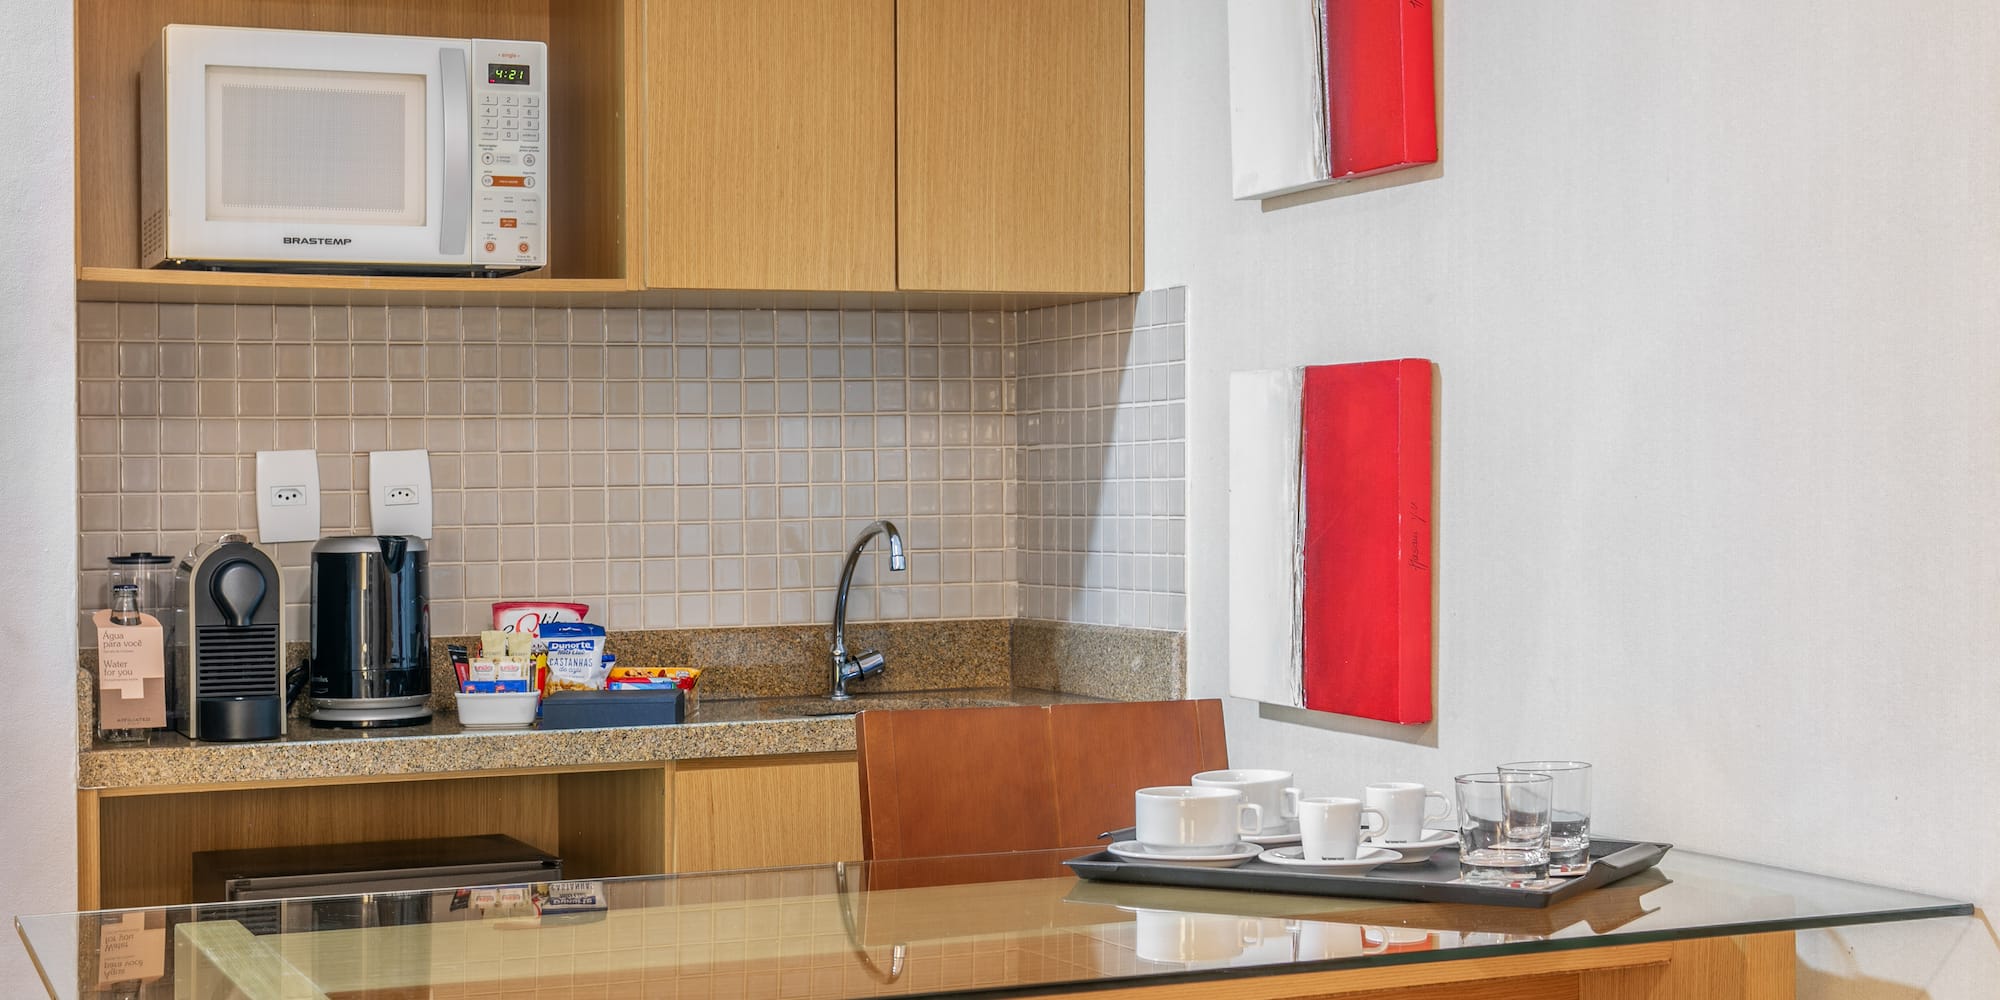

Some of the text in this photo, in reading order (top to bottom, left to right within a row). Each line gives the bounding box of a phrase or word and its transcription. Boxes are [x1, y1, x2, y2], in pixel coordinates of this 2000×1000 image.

[495, 69, 524, 80] 4:21
[283, 237, 352, 246] BRASTEMP
[103, 630, 125, 641] Água
[103, 639, 143, 649] para você
[103, 659, 128, 669] Water
[549, 657, 593, 667] CASTANHAS
[104, 669, 133, 678] for you
